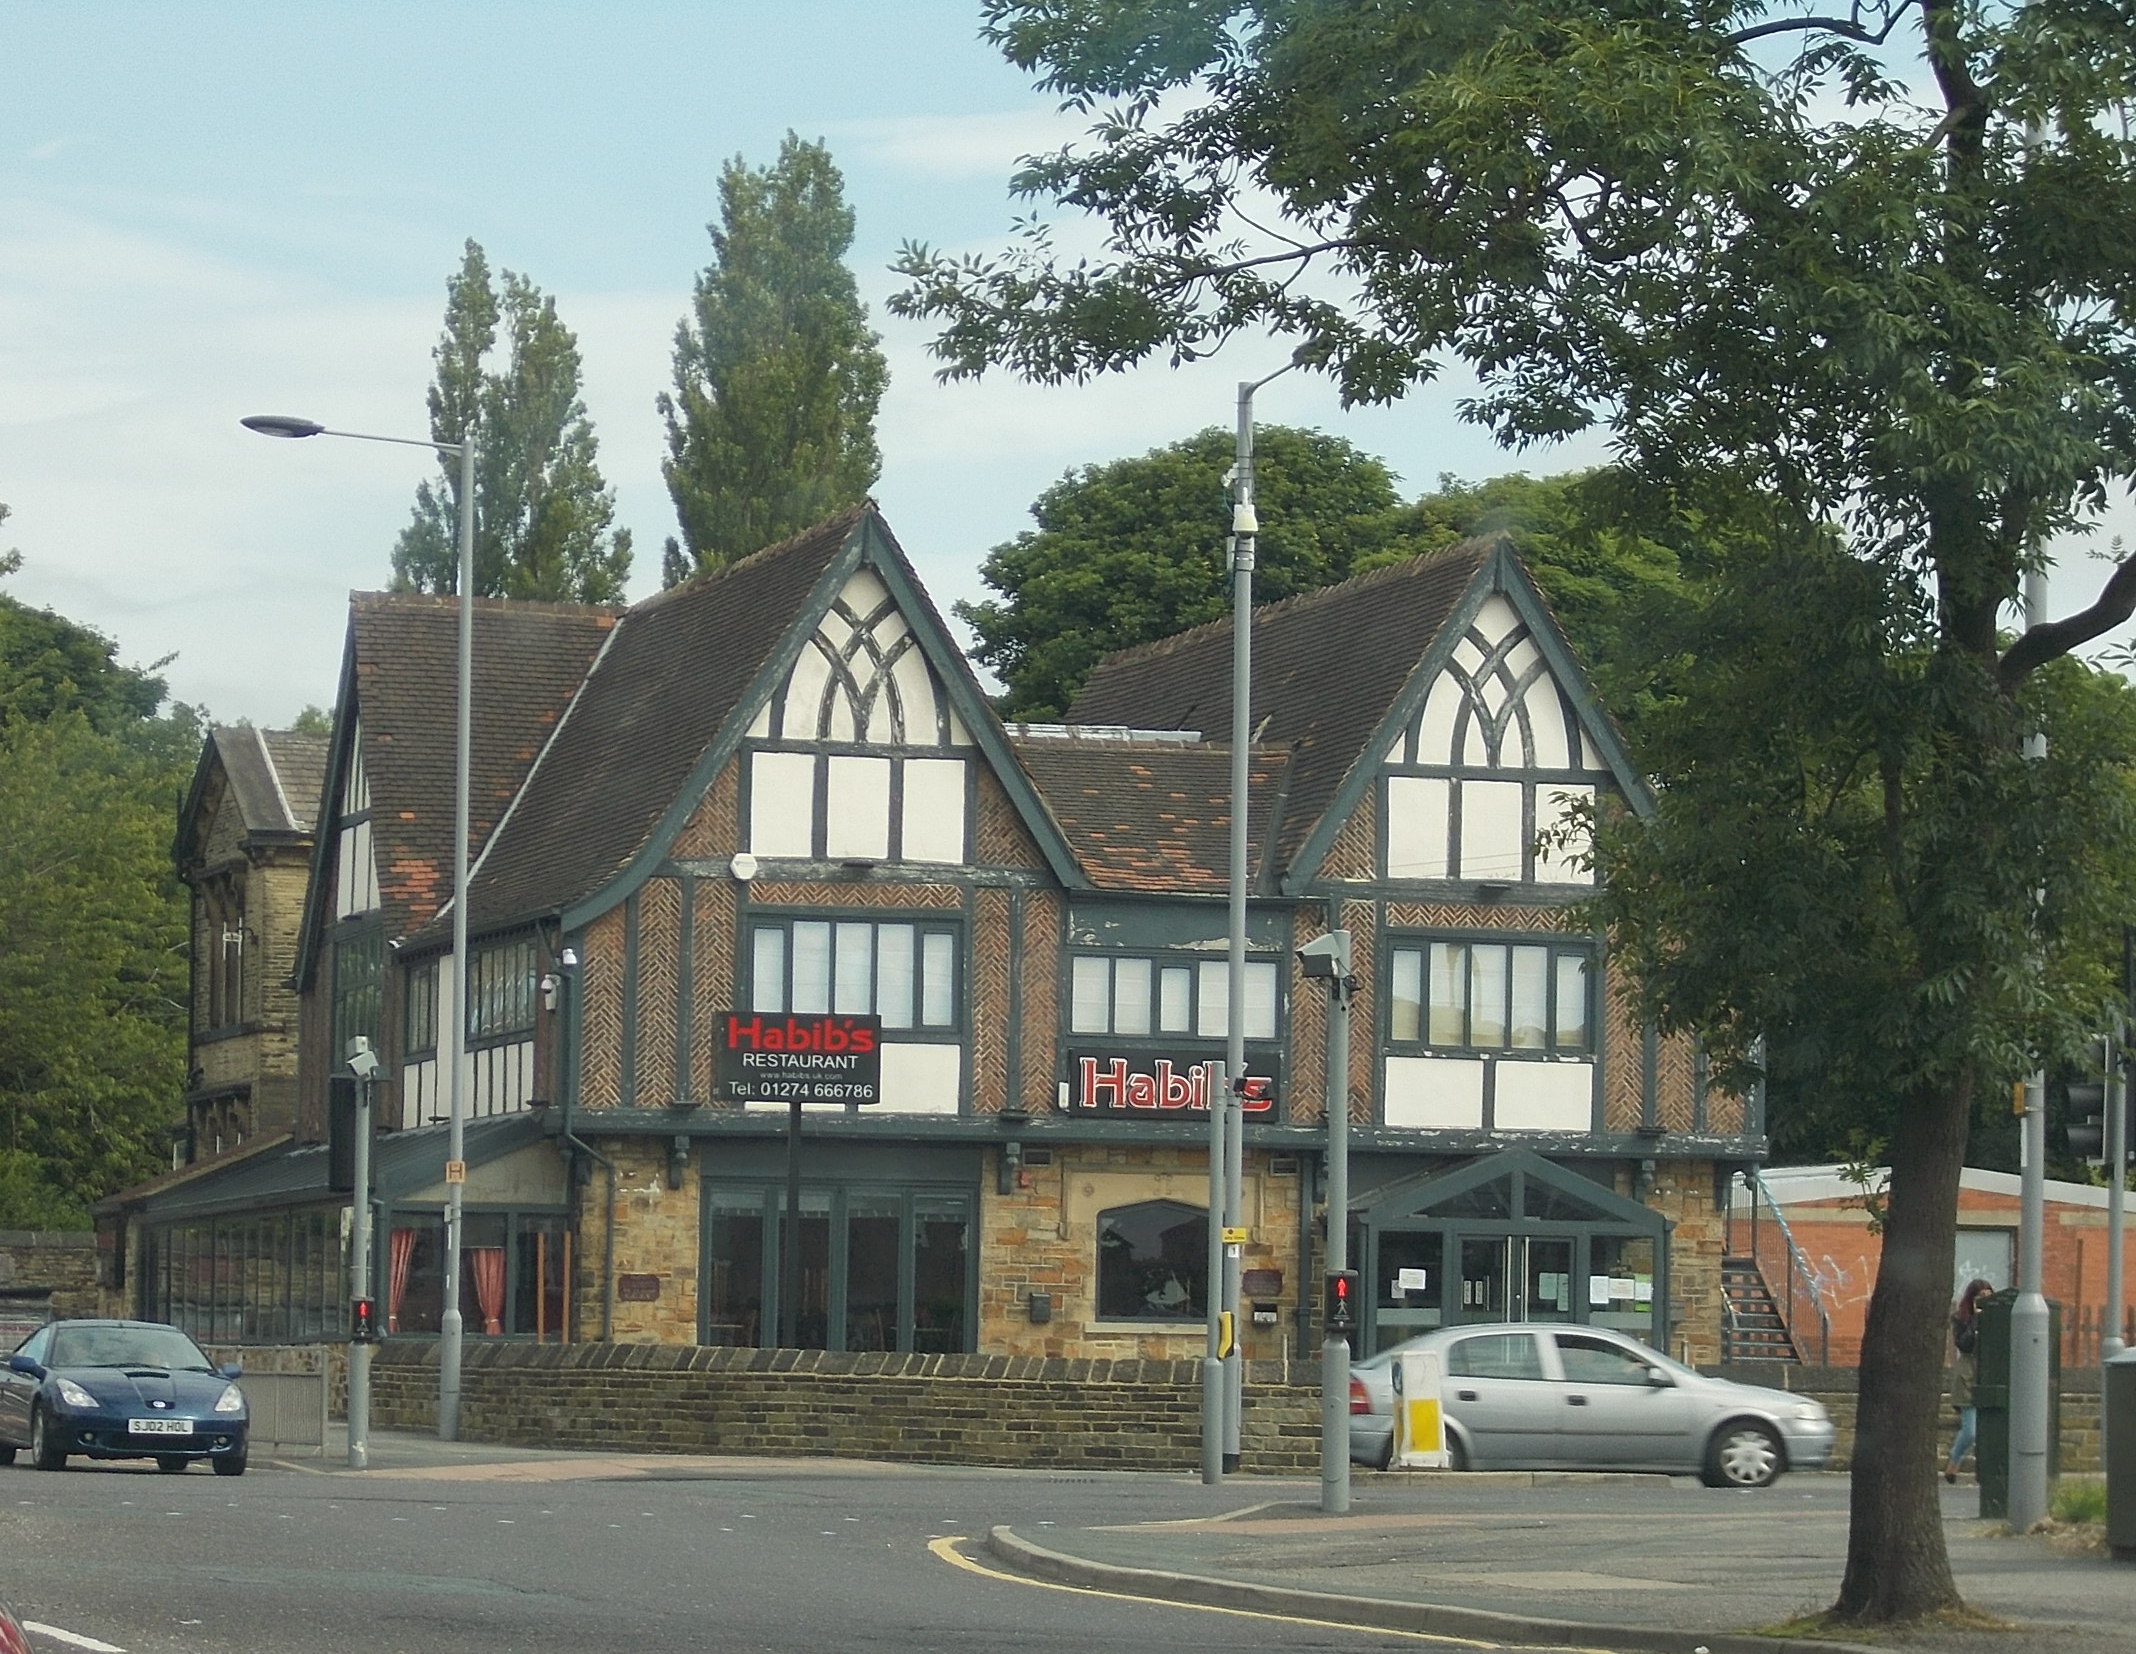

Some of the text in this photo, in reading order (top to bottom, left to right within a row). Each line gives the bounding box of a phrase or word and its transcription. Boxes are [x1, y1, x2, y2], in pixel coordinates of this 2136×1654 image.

[728, 1015, 875, 1052] Habib's
[743, 1053, 859, 1069] RESTAURANT
[729, 1081, 873, 1098] Tel: 01274 666786
[1079, 1056, 1273, 1112] Habis
[449, 1162, 463, 1179] H
